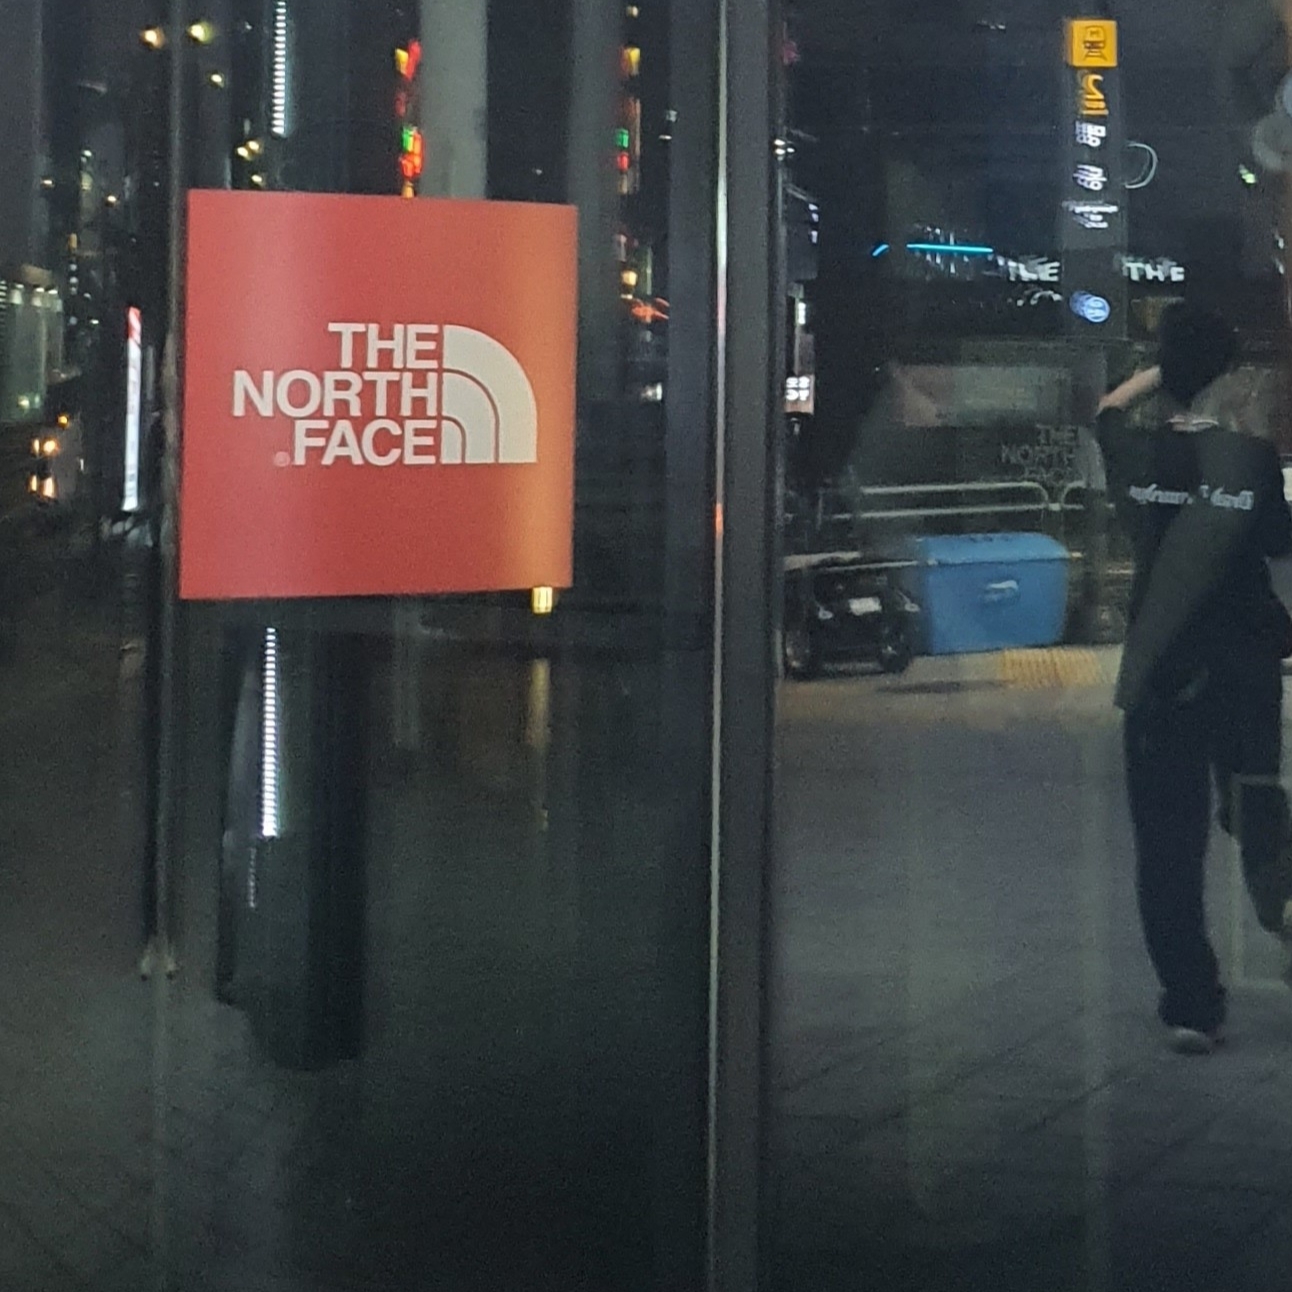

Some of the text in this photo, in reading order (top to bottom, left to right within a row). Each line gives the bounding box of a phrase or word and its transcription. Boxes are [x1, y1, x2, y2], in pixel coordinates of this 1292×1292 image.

[328, 322, 439, 369] THE
[233, 369, 438, 418] NORTH
[292, 418, 437, 466] FACE
